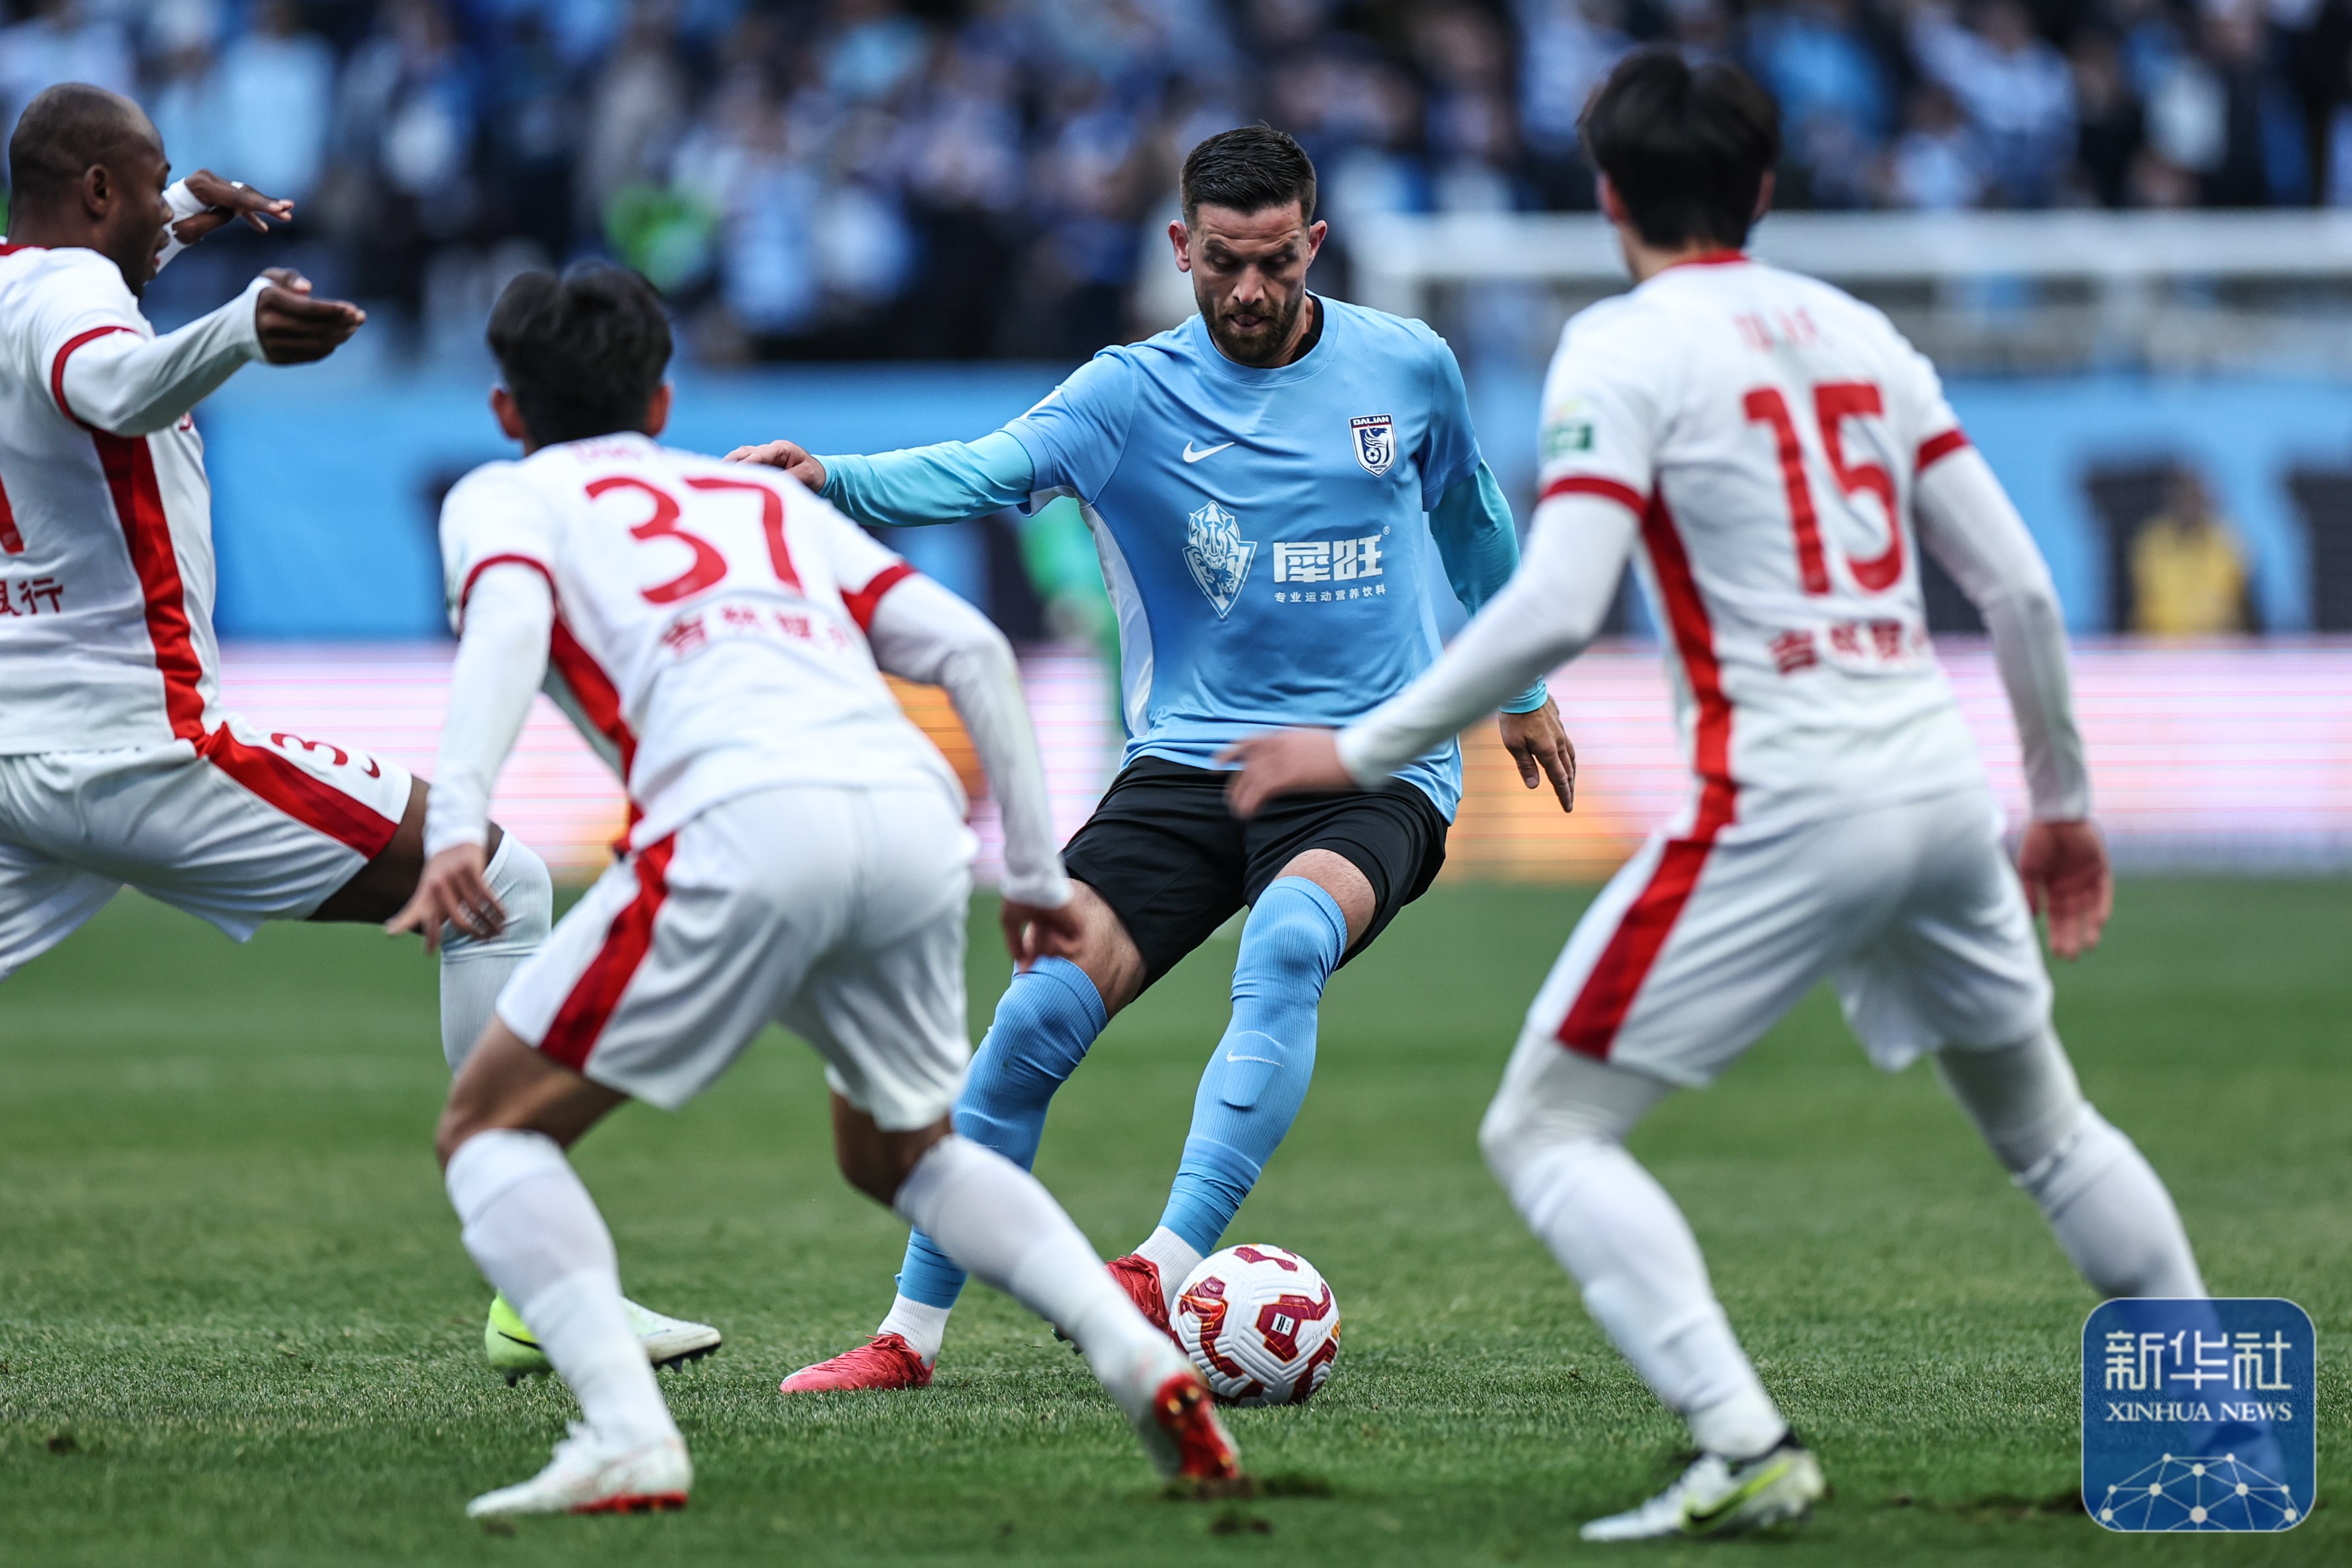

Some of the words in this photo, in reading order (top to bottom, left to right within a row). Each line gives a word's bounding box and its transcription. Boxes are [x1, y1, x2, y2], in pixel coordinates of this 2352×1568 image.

[1353, 416, 1389, 426] DALIAN
[1742, 379, 1905, 597] 15
[585, 476, 804, 604] 37
[1273, 534, 1383, 583] 犀旺
[1274, 584, 1386, 603] 专业运动营养饮料
